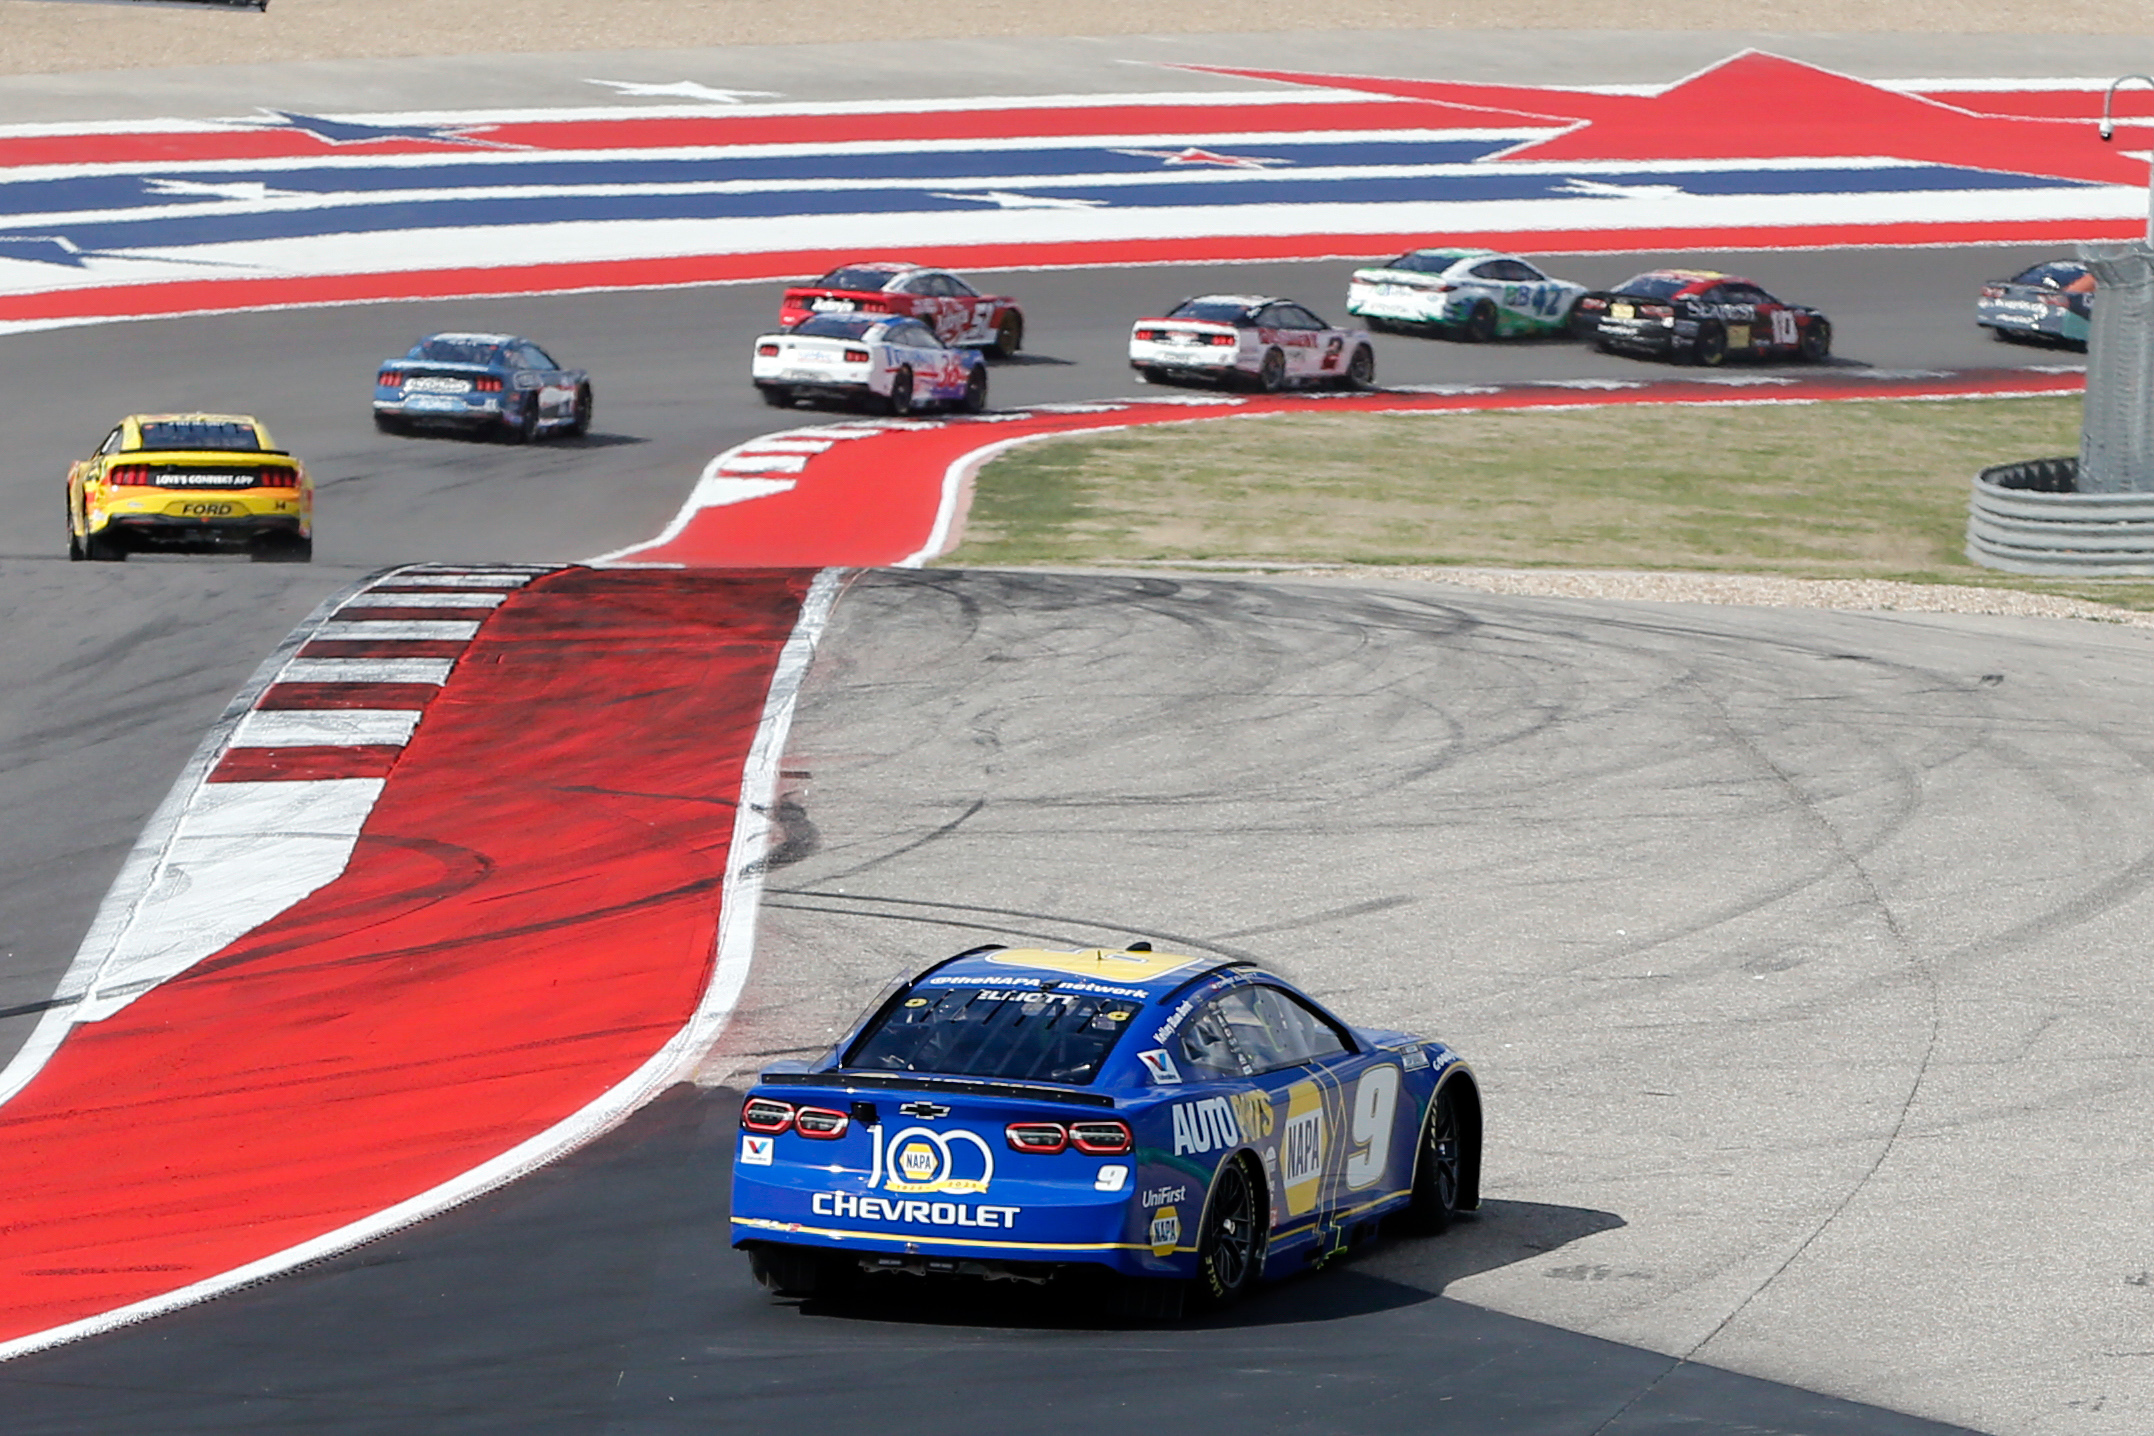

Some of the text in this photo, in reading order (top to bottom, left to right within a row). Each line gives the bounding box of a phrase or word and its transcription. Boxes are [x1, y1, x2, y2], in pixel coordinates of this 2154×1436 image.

[1771, 310, 1799, 345] 10
[1320, 336, 1343, 370] 2
[182, 503, 232, 516] FORD
[1172, 1096, 1239, 1156] AUTO
[1346, 1063, 1400, 1191] 9
[906, 1153, 932, 1171] NAPA
[1287, 1116, 1320, 1180] NAPA
[1094, 1164, 1130, 1192] 9
[812, 1193, 1021, 1229] CHEVROLET
[1142, 1185, 1186, 1208] UniFirst
